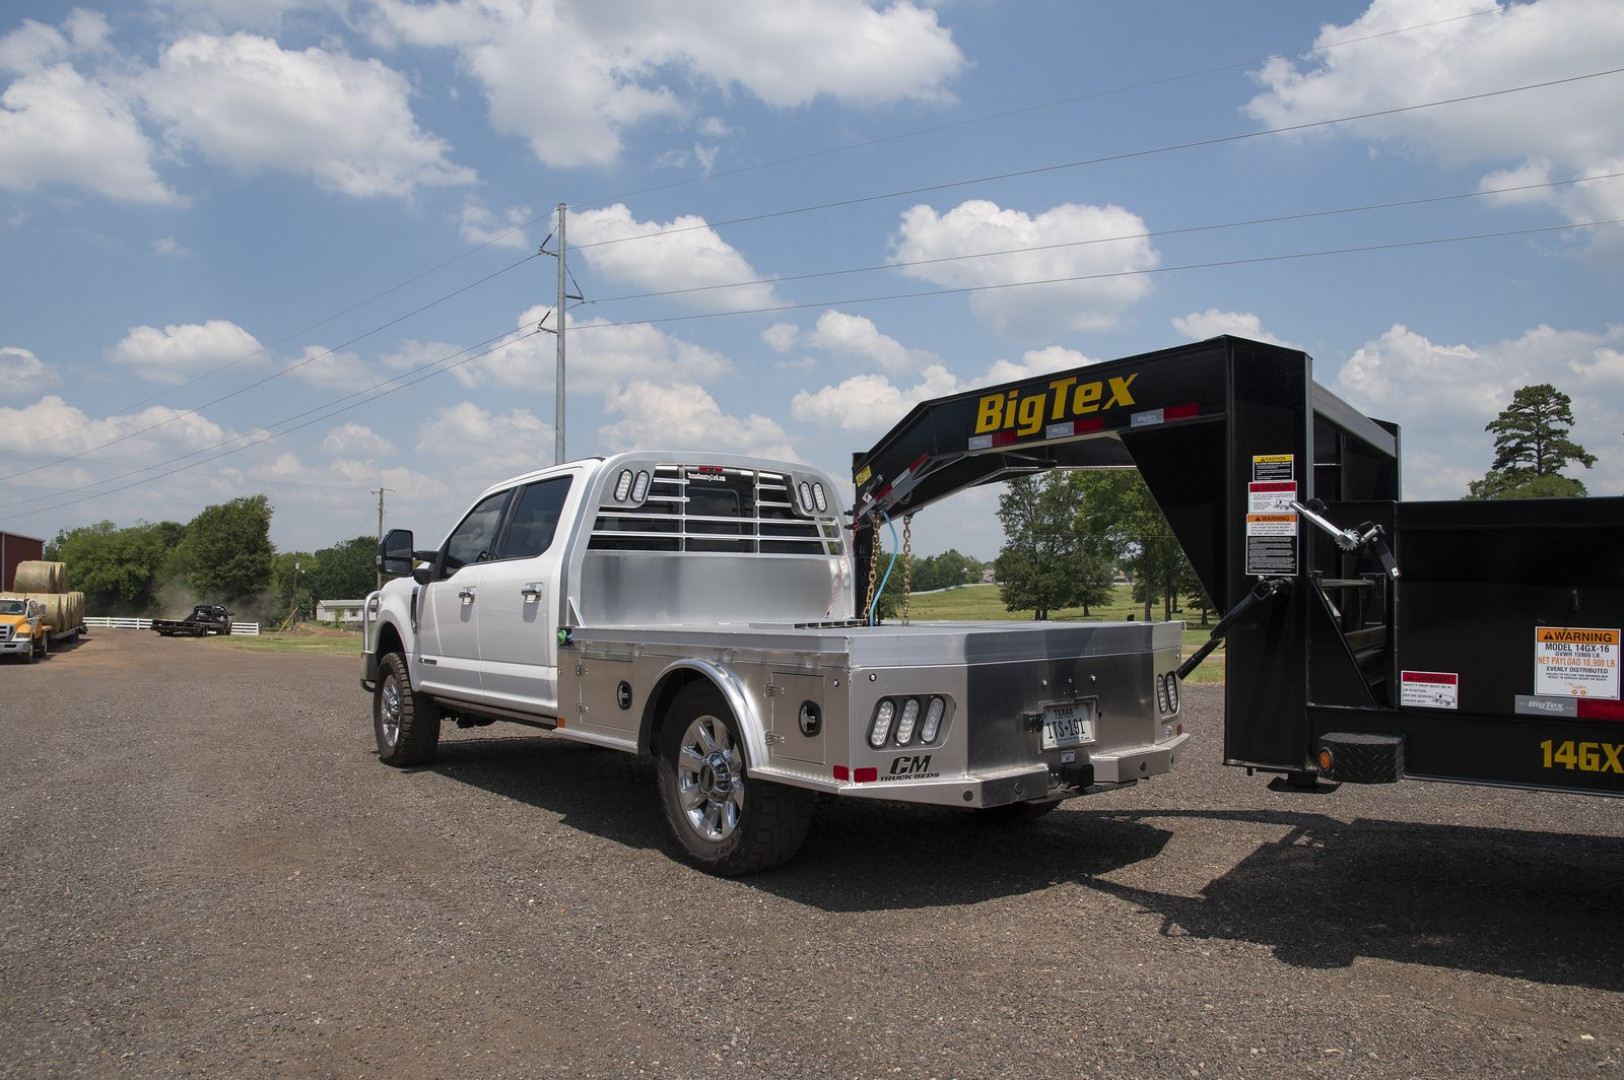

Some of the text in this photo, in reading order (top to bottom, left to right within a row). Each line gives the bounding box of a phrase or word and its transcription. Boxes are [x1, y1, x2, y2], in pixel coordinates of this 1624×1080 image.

[975, 373, 1138, 436] BigTex
[1554, 631, 1612, 642] WARNING
[1545, 643, 1610, 653] MODEL 14GX-16
[1538, 656, 1550, 664] NET
[1552, 657, 1581, 666] PAYLOAD
[1528, 700, 1564, 710] BigTex
[890, 755, 932, 774] CM
